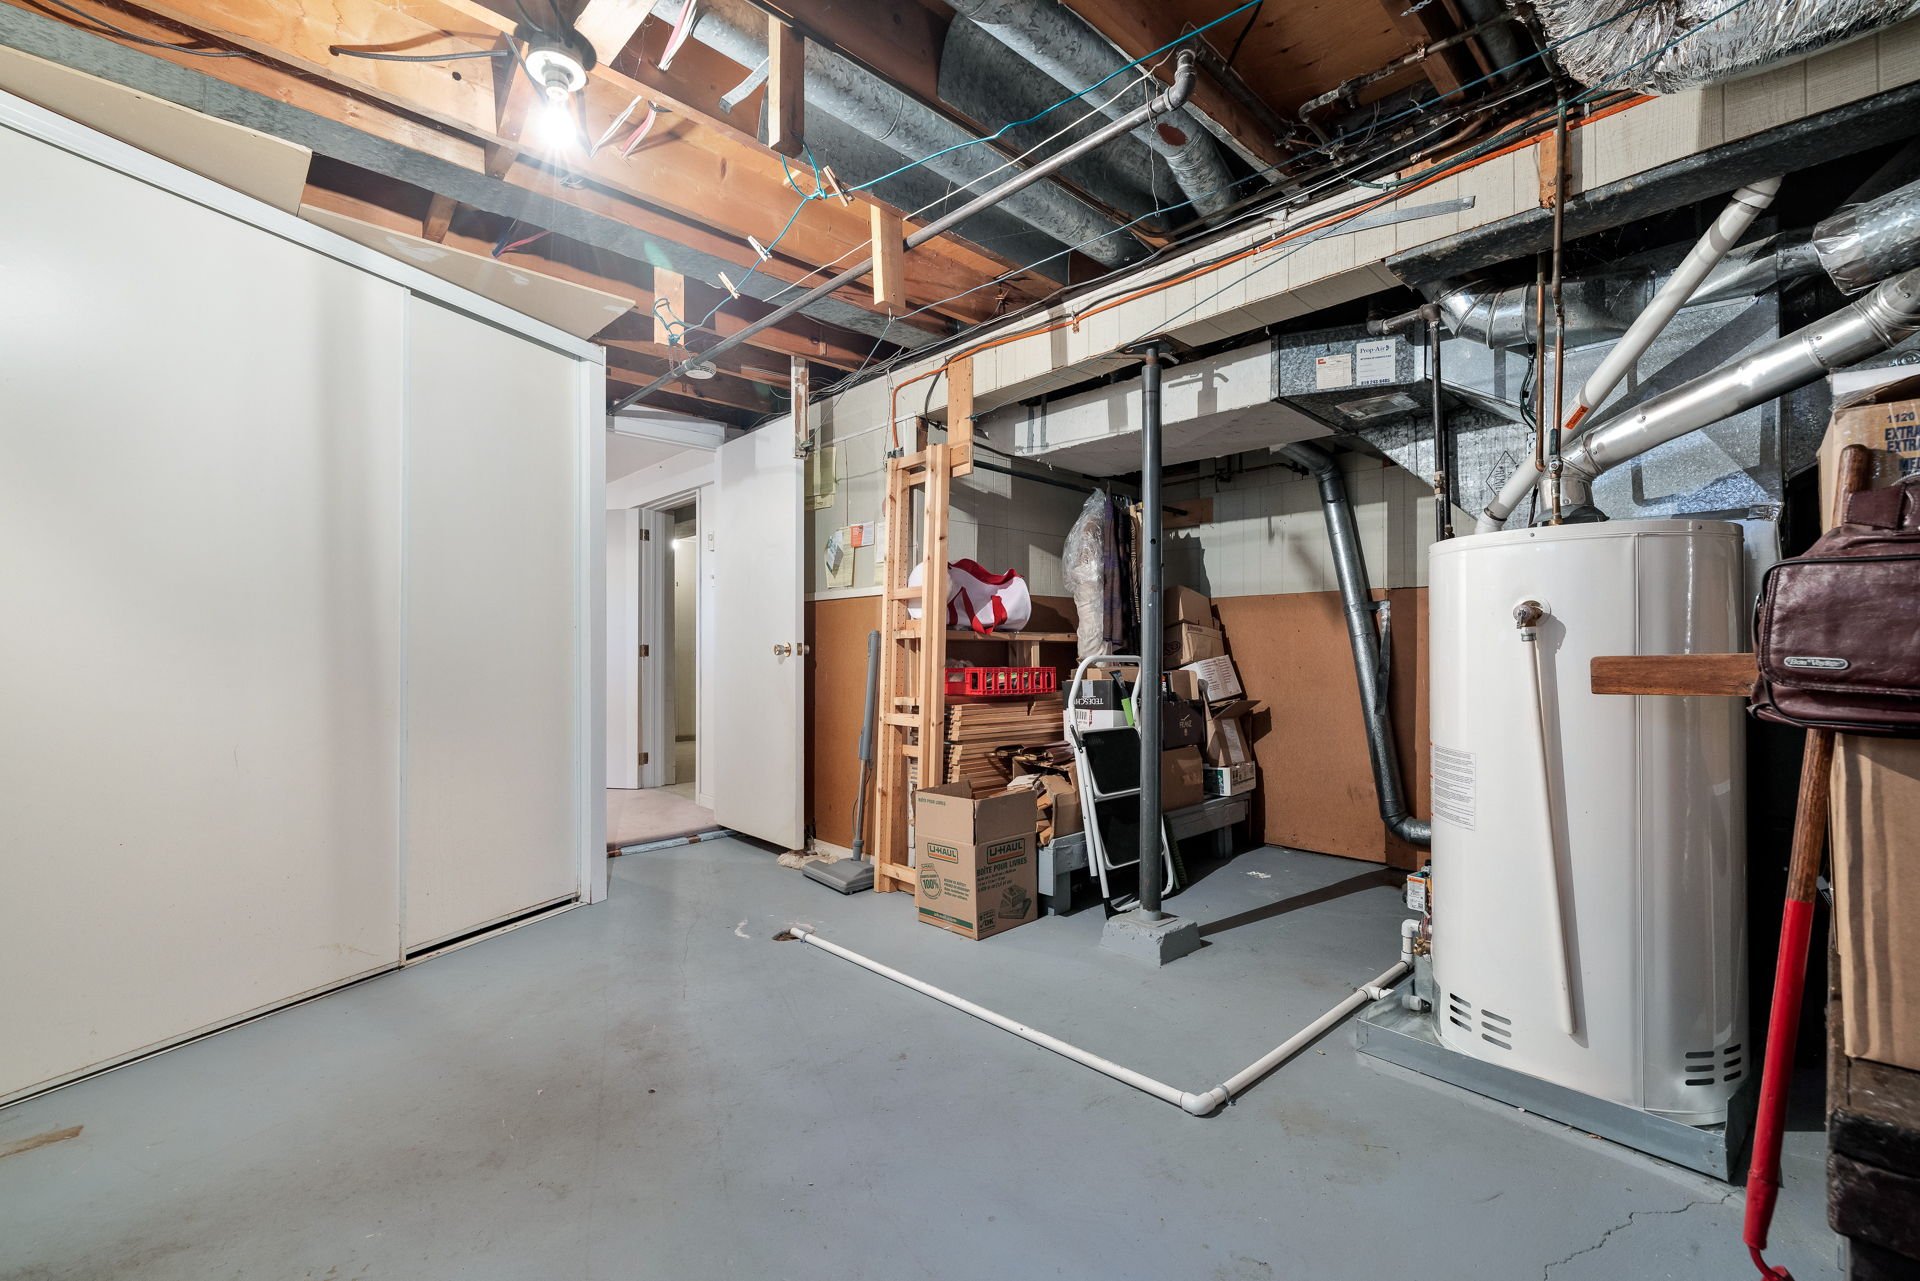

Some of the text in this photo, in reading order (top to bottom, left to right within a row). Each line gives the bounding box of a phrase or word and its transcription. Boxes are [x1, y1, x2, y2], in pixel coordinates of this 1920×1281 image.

[1886, 411, 1915, 423] 1120
[1887, 438, 1920, 455] EXTR
[929, 845, 957, 858] U-HAUL
[989, 840, 1023, 856] U-HAUL
[994, 862, 1008, 873] POUR
